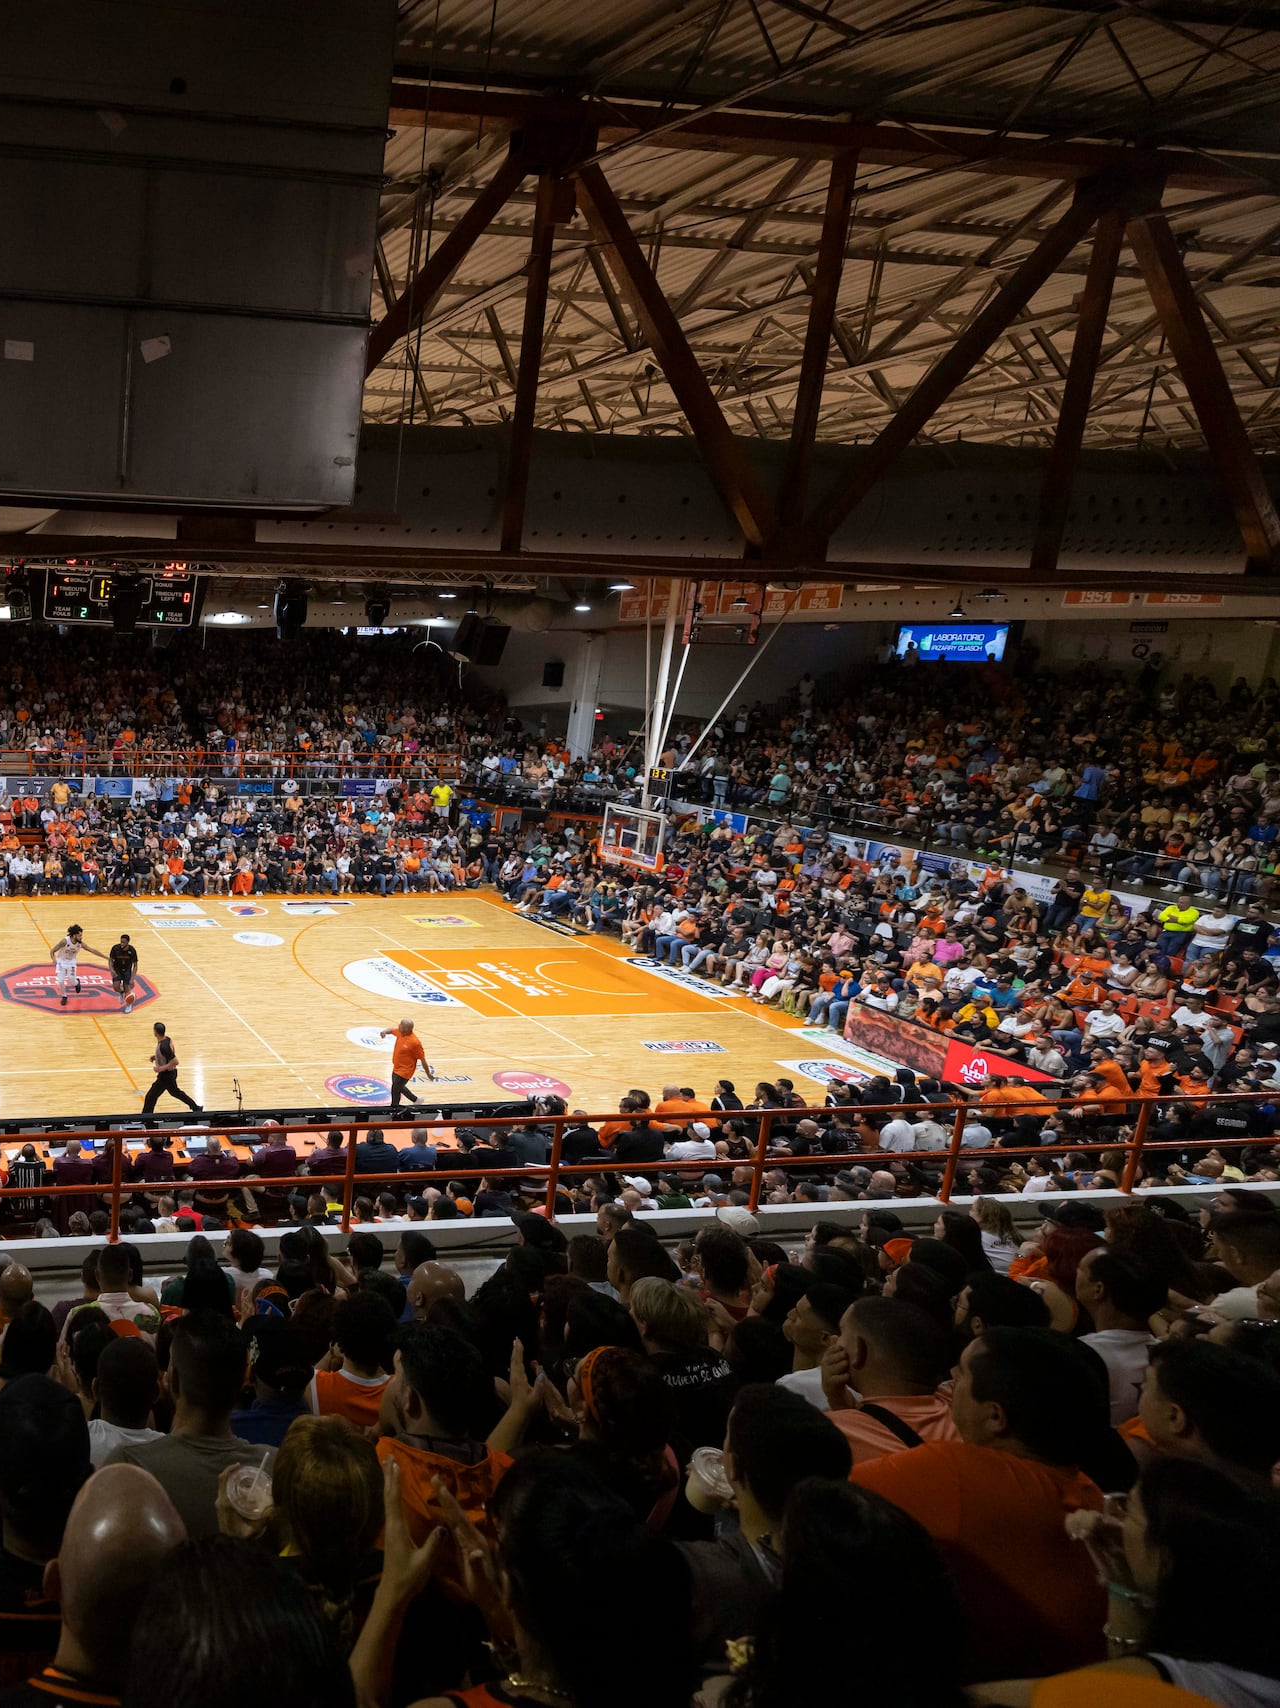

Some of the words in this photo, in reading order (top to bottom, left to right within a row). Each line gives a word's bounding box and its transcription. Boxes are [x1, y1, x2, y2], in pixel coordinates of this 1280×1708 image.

[183, 592, 191, 604] 0
[80, 608, 89, 618] 2
[156, 611, 164, 622] 4
[933, 633, 985, 642] LABORATORIO
[1132, 644, 1149, 660] Q
[501, 1076, 553, 1091] Claro
